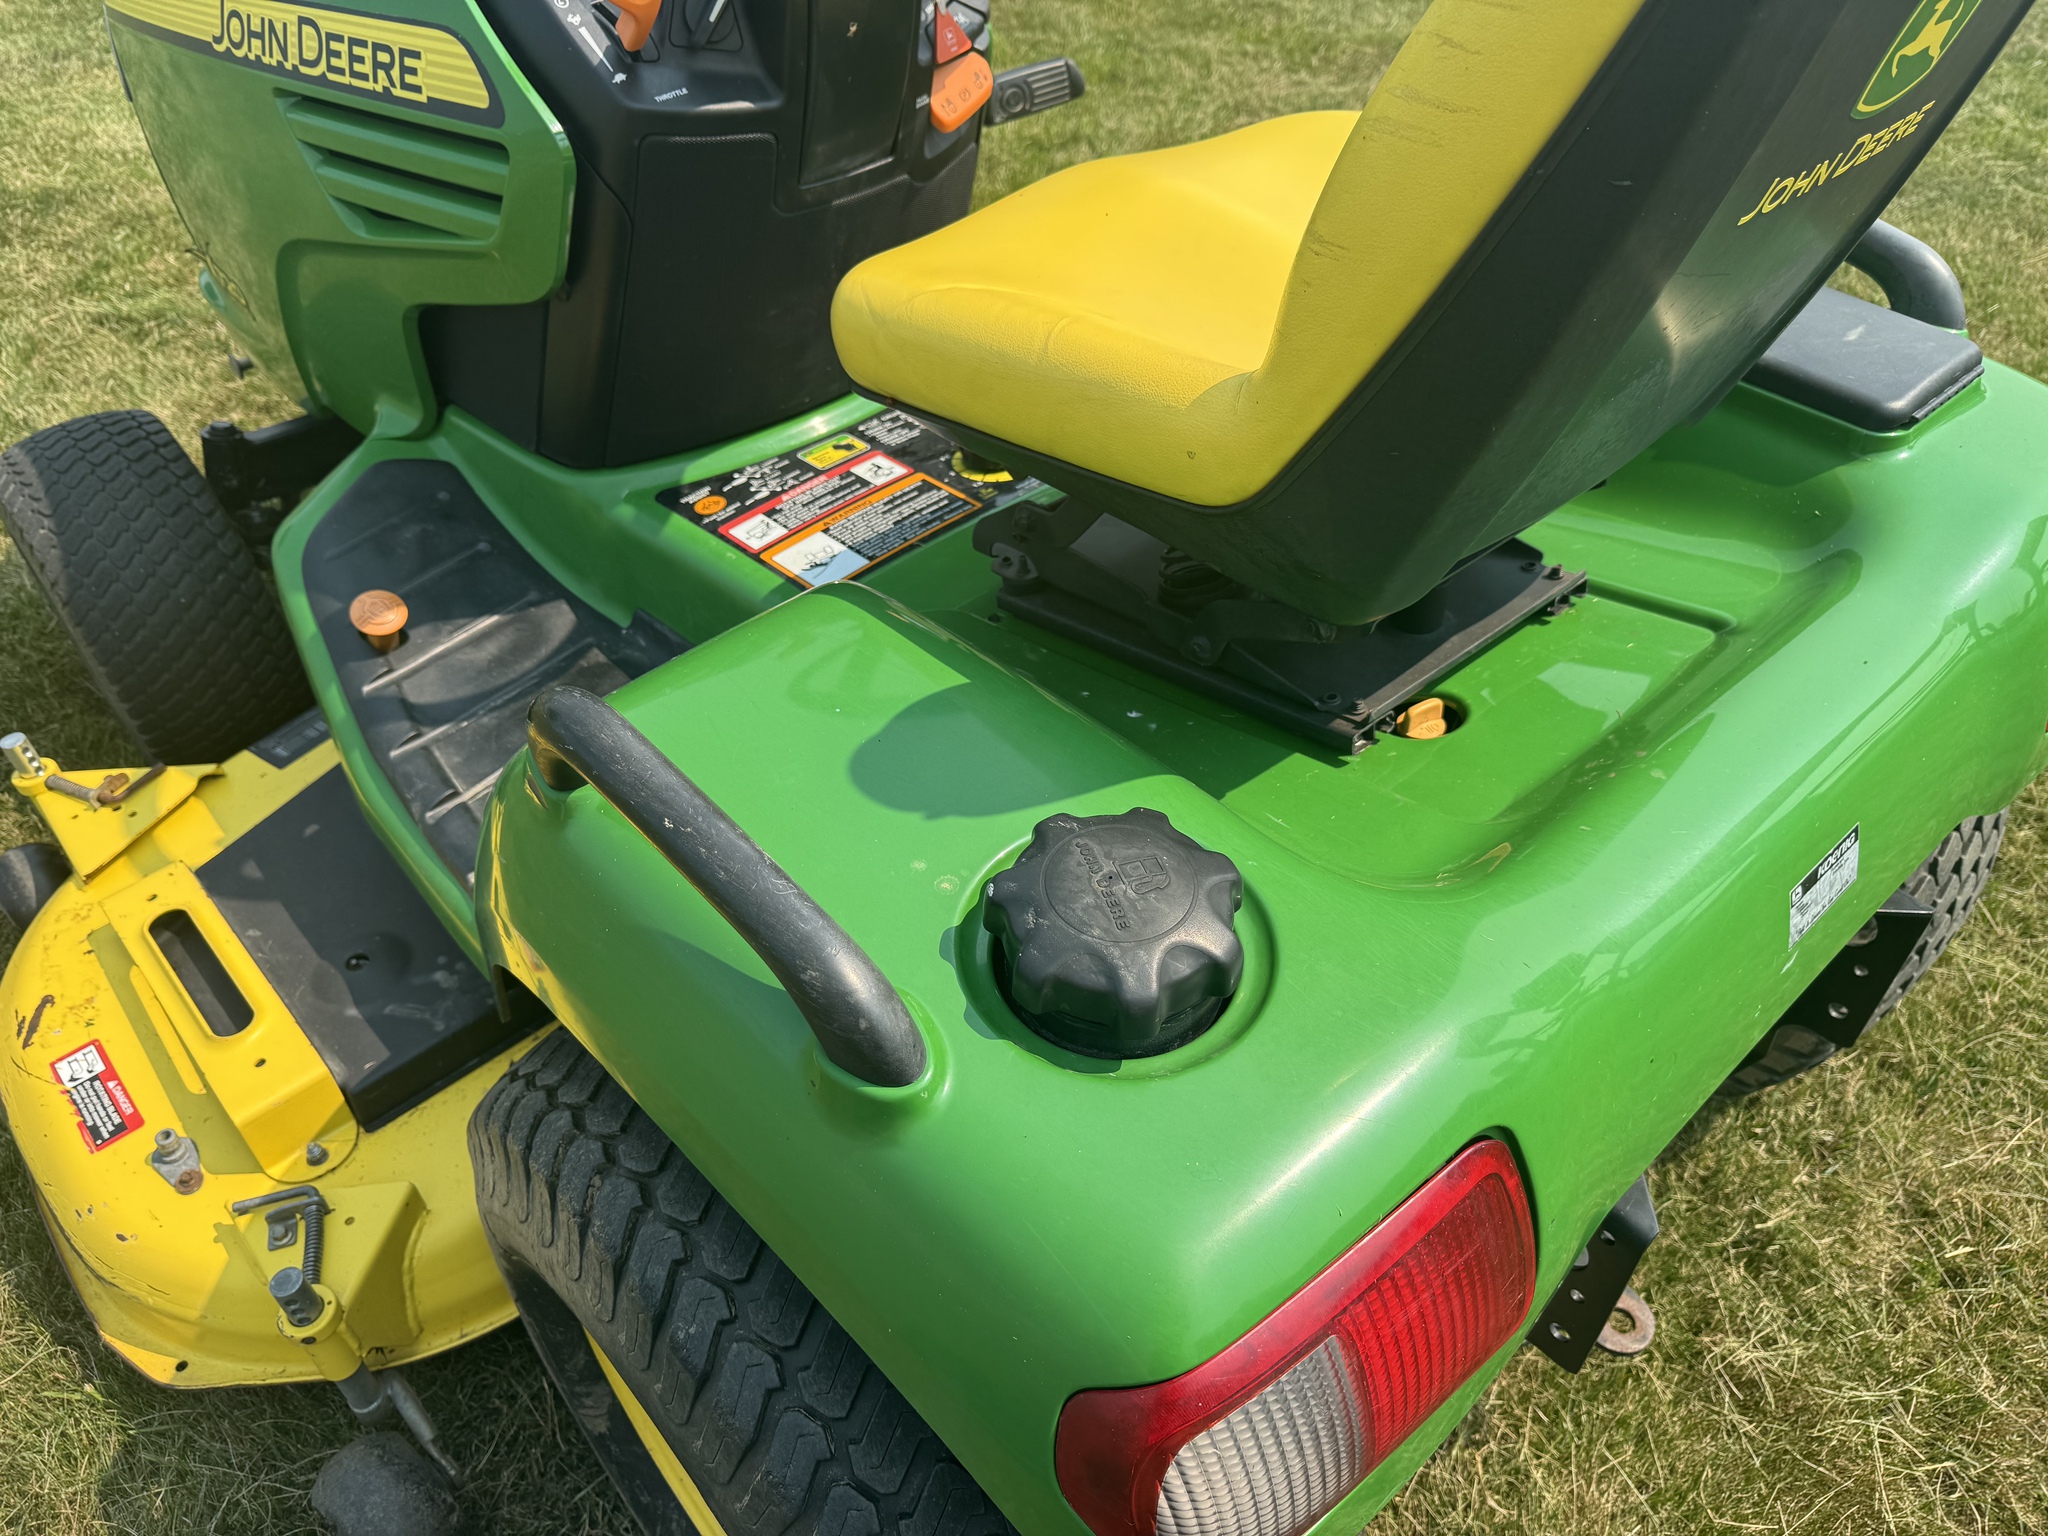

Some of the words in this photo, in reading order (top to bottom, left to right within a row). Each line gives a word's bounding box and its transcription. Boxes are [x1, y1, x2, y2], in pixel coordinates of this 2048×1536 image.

[211, 0, 290, 65] JOHN
[297, 15, 424, 97] DEERE
[654, 87, 688, 102] THROTTLE
[1737, 153, 1843, 226] JOHN
[1832, 100, 1936, 179] DEERE
[832, 500, 873, 523] WARNING
[1075, 841, 1102, 875] JOHN
[1096, 876, 1131, 931] DEERE
[91, 1078, 112, 1108] ROTATING
[105, 1104, 122, 1126] BLADE
[110, 1084, 134, 1116] DANGER
